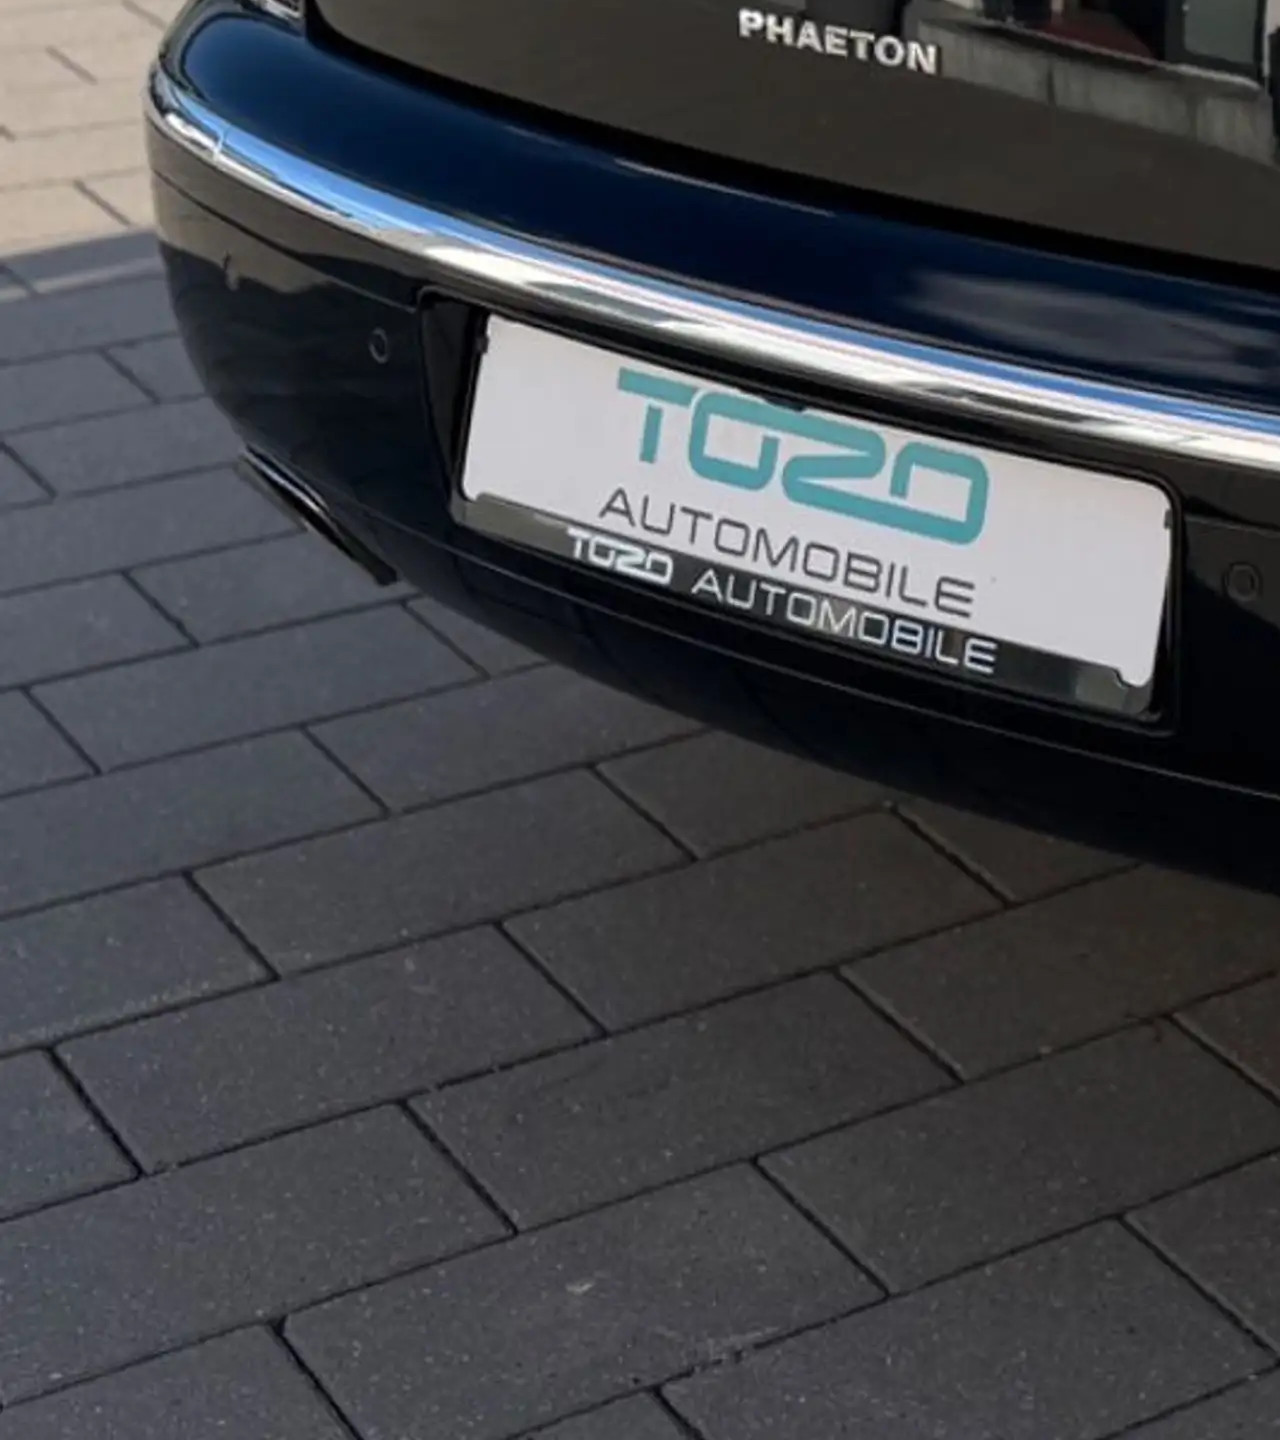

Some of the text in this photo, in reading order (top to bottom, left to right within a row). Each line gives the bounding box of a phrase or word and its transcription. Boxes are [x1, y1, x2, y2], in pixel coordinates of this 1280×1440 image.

[738, 8, 937, 75] PHAETON
[600, 487, 976, 618] AUTOMOBILE
[690, 568, 998, 674] AUTOMOBILE
